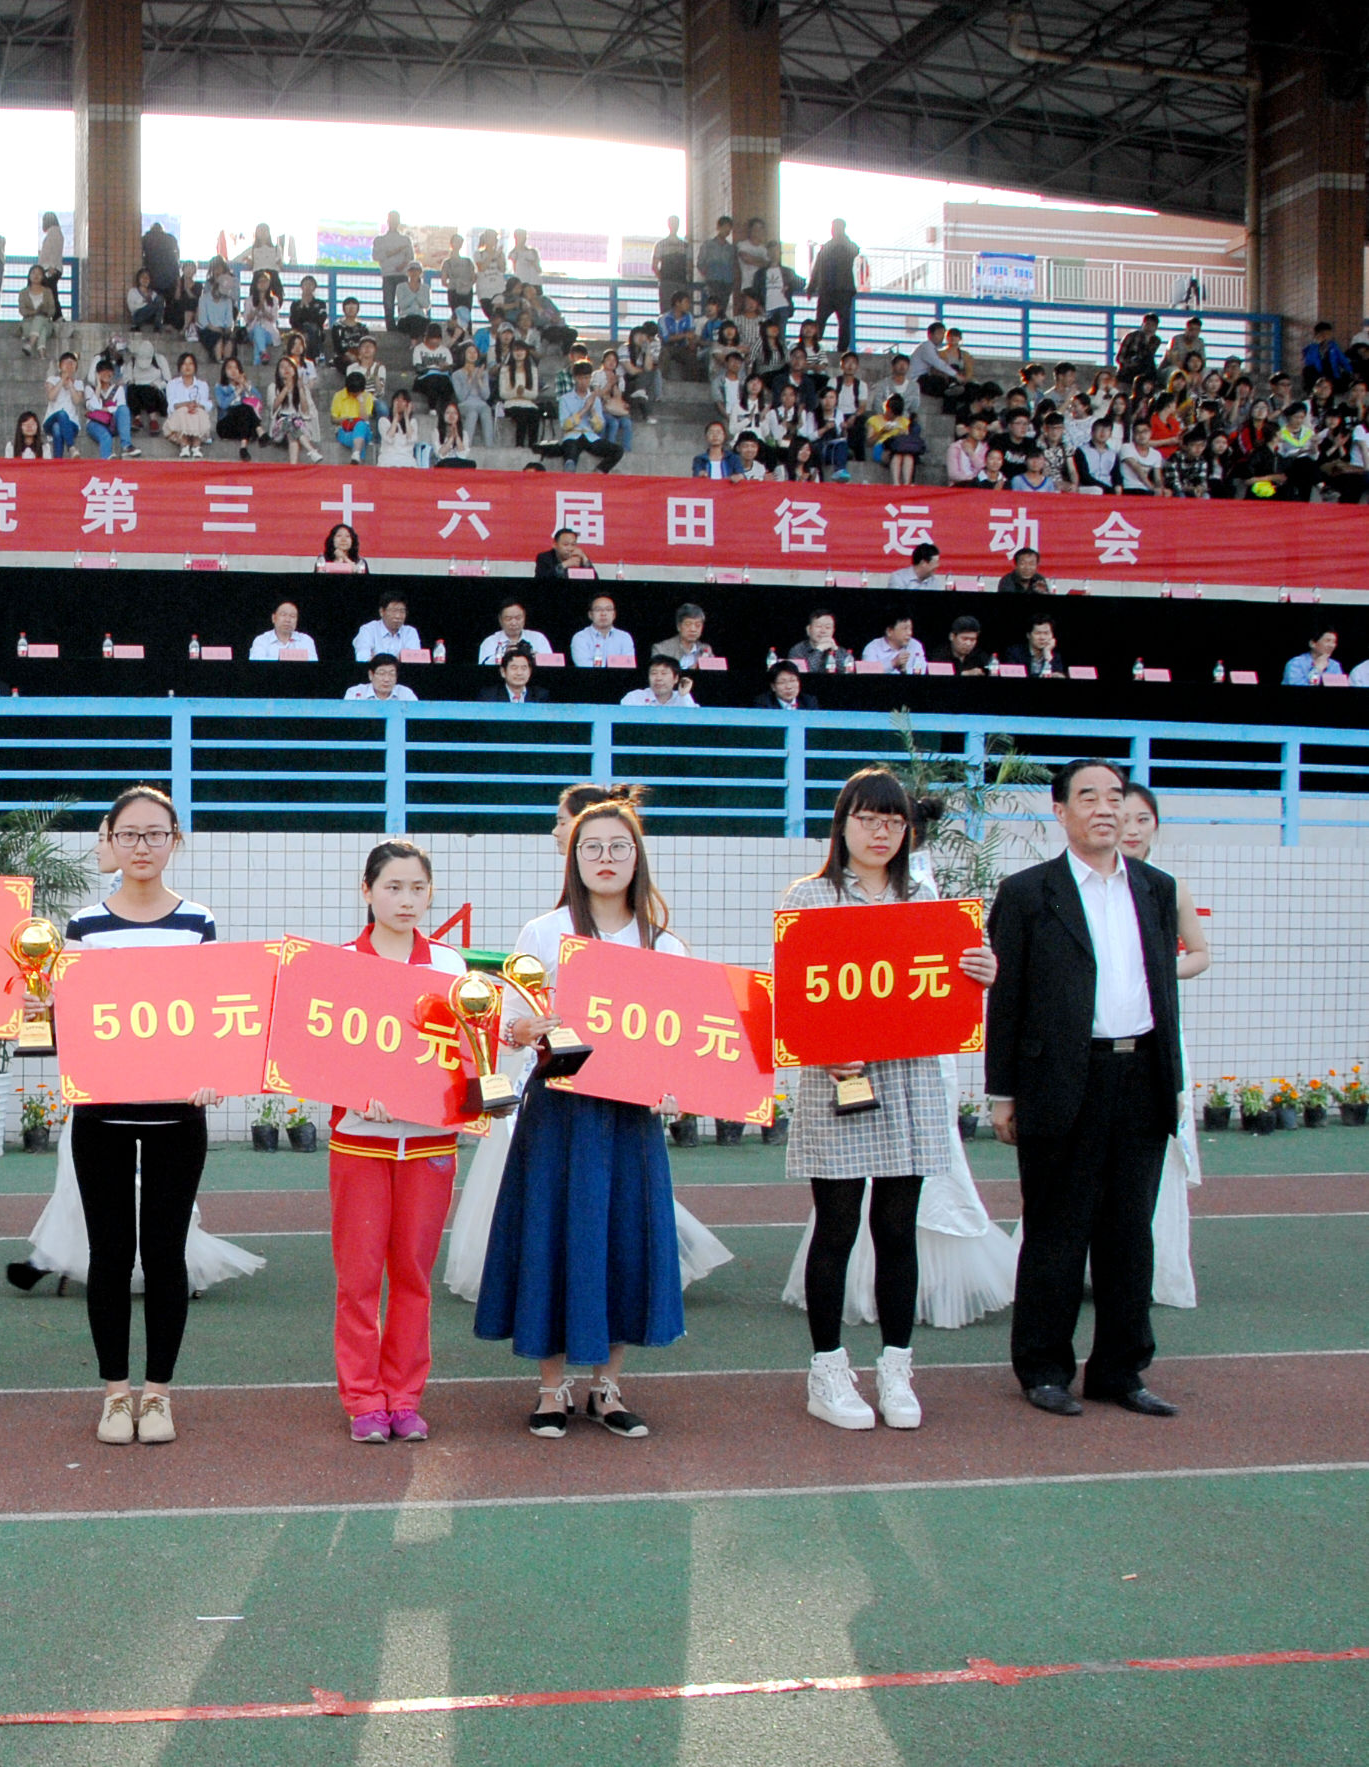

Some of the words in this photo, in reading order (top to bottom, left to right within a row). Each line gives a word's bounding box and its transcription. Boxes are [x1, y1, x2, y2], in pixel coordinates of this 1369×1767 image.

[806, 960, 894, 1003] 500
[909, 954, 950, 1000] 元
[92, 999, 195, 1041] 500
[211, 993, 262, 1039] 元
[306, 998, 402, 1053] 500
[414, 1022, 461, 1070] 元
[586, 995, 681, 1047] 500
[694, 1014, 740, 1062] 元
